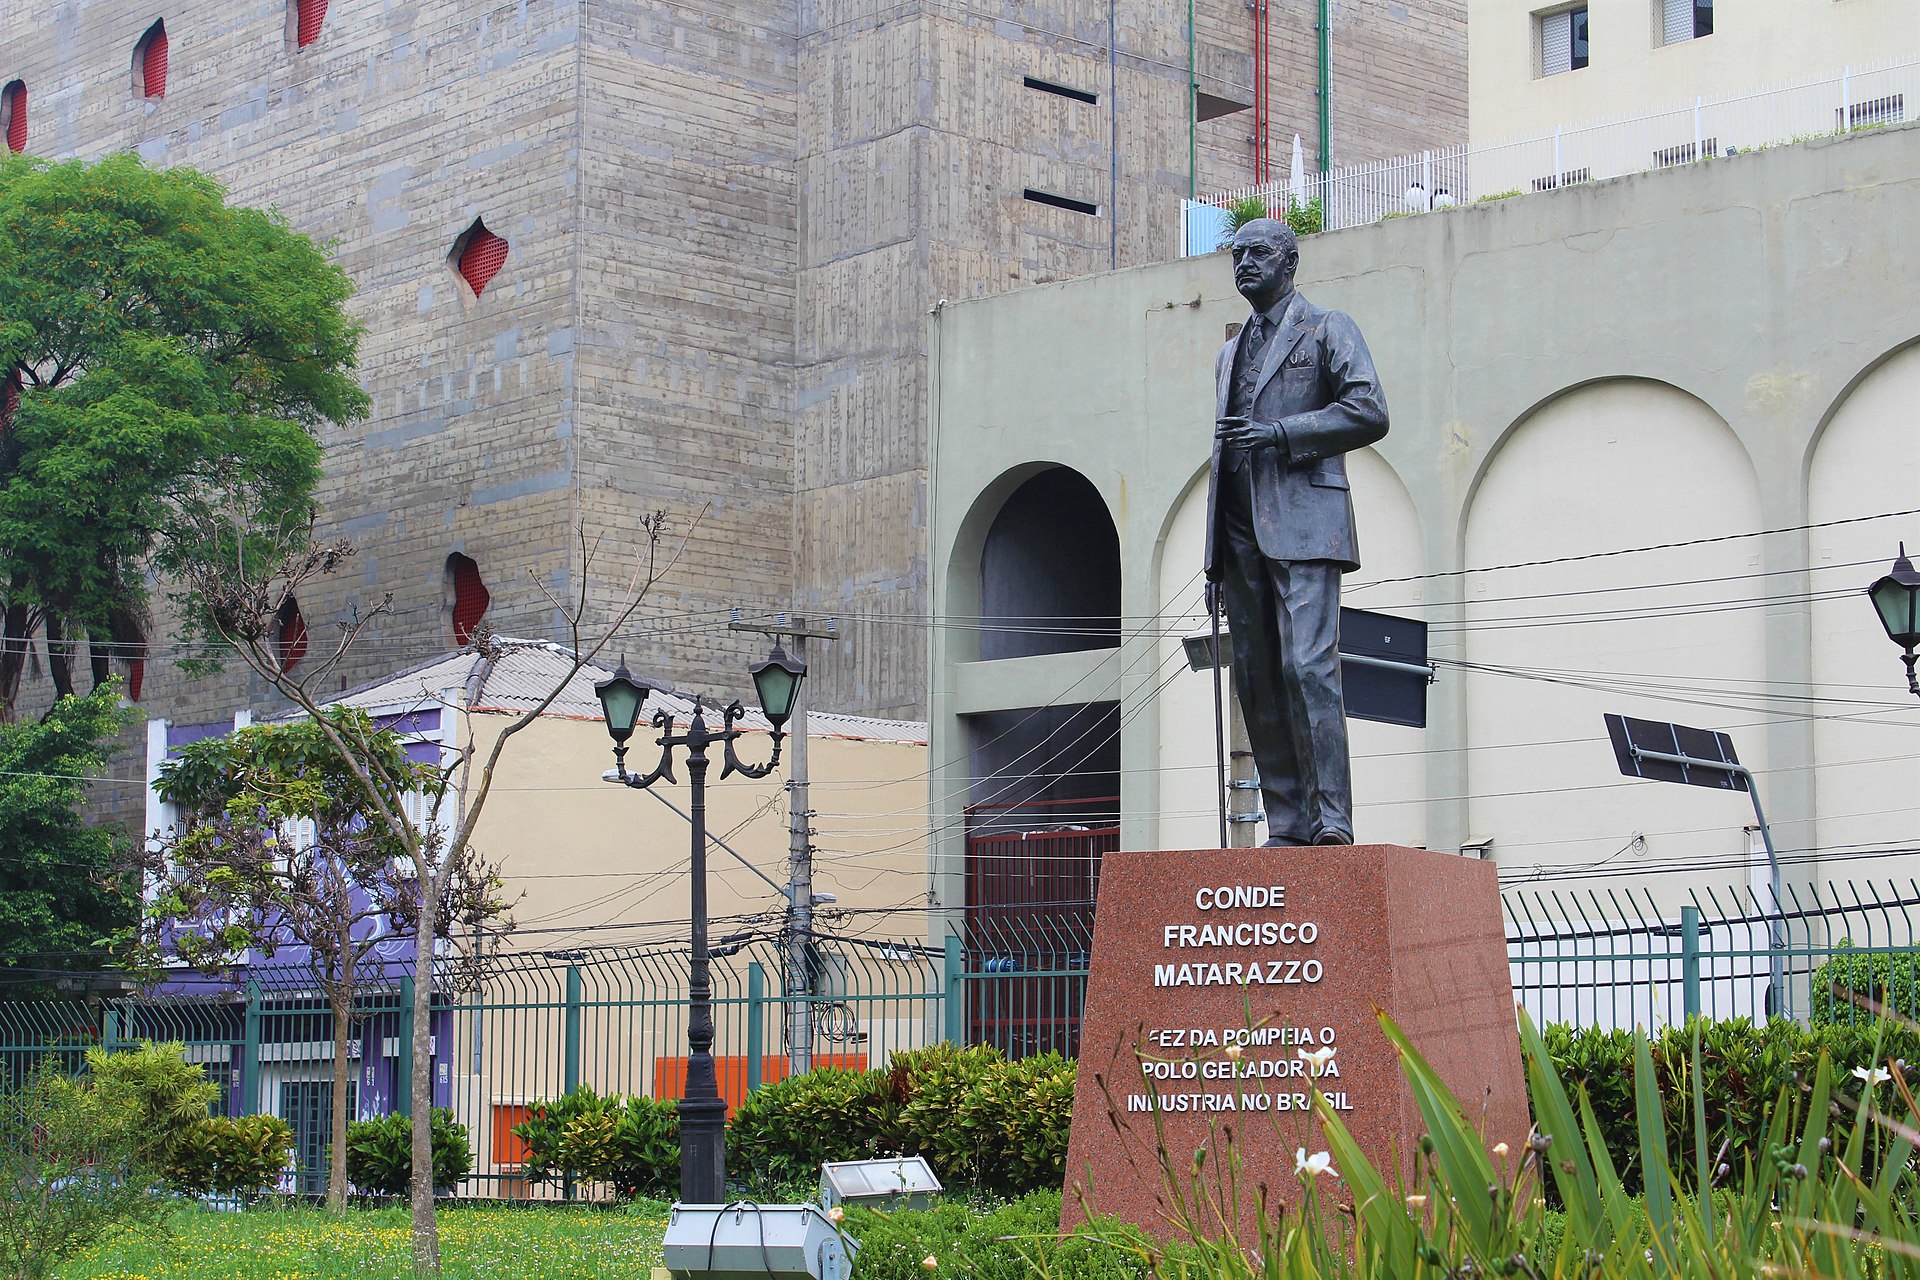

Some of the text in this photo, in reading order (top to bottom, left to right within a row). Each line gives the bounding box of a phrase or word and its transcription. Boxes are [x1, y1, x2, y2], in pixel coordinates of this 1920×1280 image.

[1195, 885, 1286, 911] CONDE
[1163, 922, 1318, 948] FRANCISCO
[1154, 959, 1323, 987] MATARAZZO
[1190, 1029, 1219, 1047] DA
[1222, 1027, 1315, 1047] POMPEIA
[1319, 1026, 1336, 1045] O
[1141, 1062, 1197, 1079] POLO
[1241, 1093, 1271, 1111] NO
[1277, 1092, 1354, 1111] BRSIL
